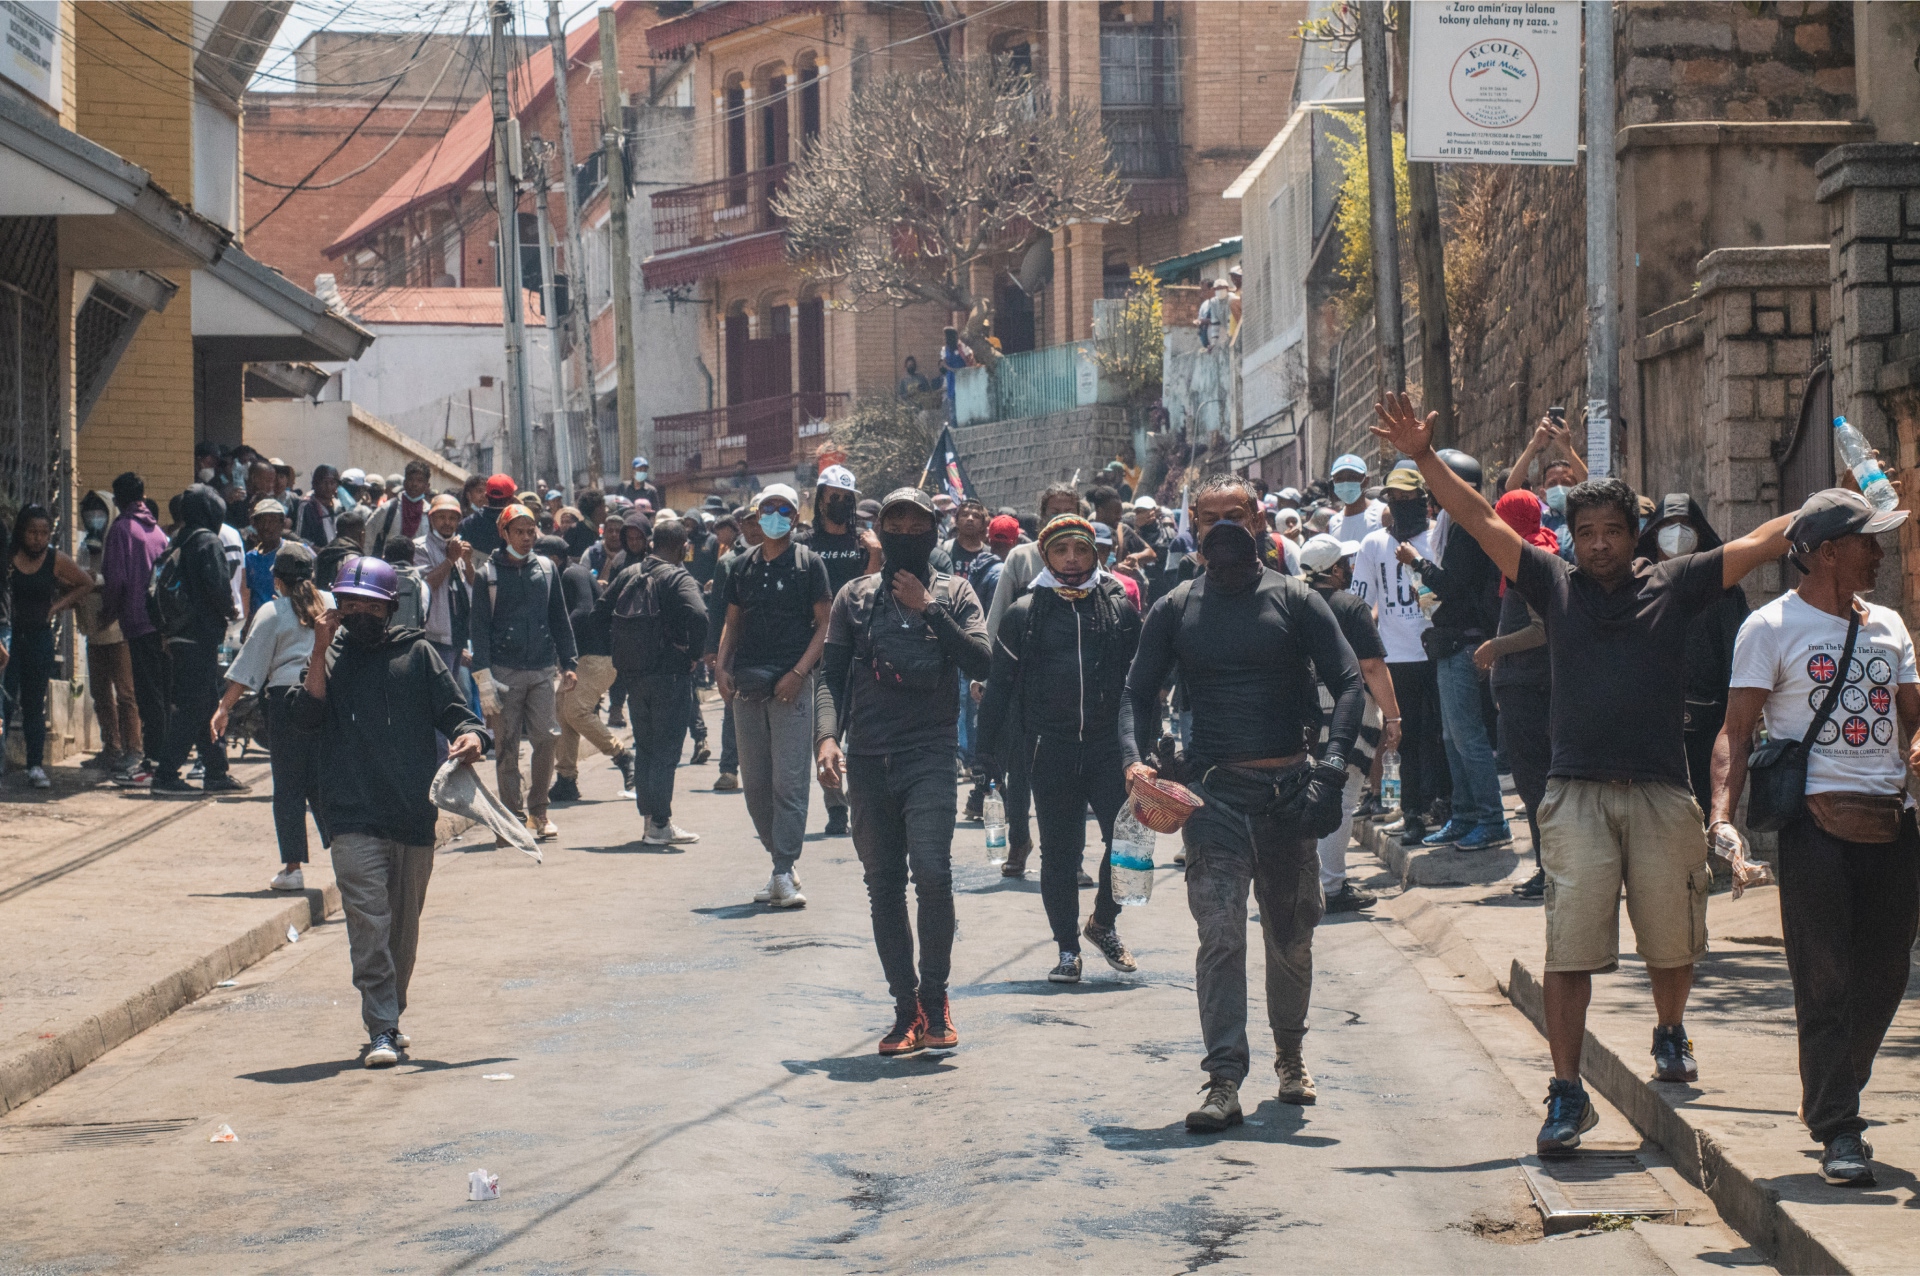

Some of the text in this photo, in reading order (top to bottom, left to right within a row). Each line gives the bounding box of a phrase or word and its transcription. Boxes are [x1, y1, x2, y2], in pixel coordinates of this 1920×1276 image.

[1454, 2, 1475, 12] Zaro
[1439, 14, 1470, 26] tokony
[1473, 15, 1510, 27] alehany
[1513, 18, 1523, 28] ny
[1469, 43, 1523, 60] ECOLE
[1465, 60, 1527, 77] Au Petit Monde
[1474, 148, 1509, 156] Mandrosoa
